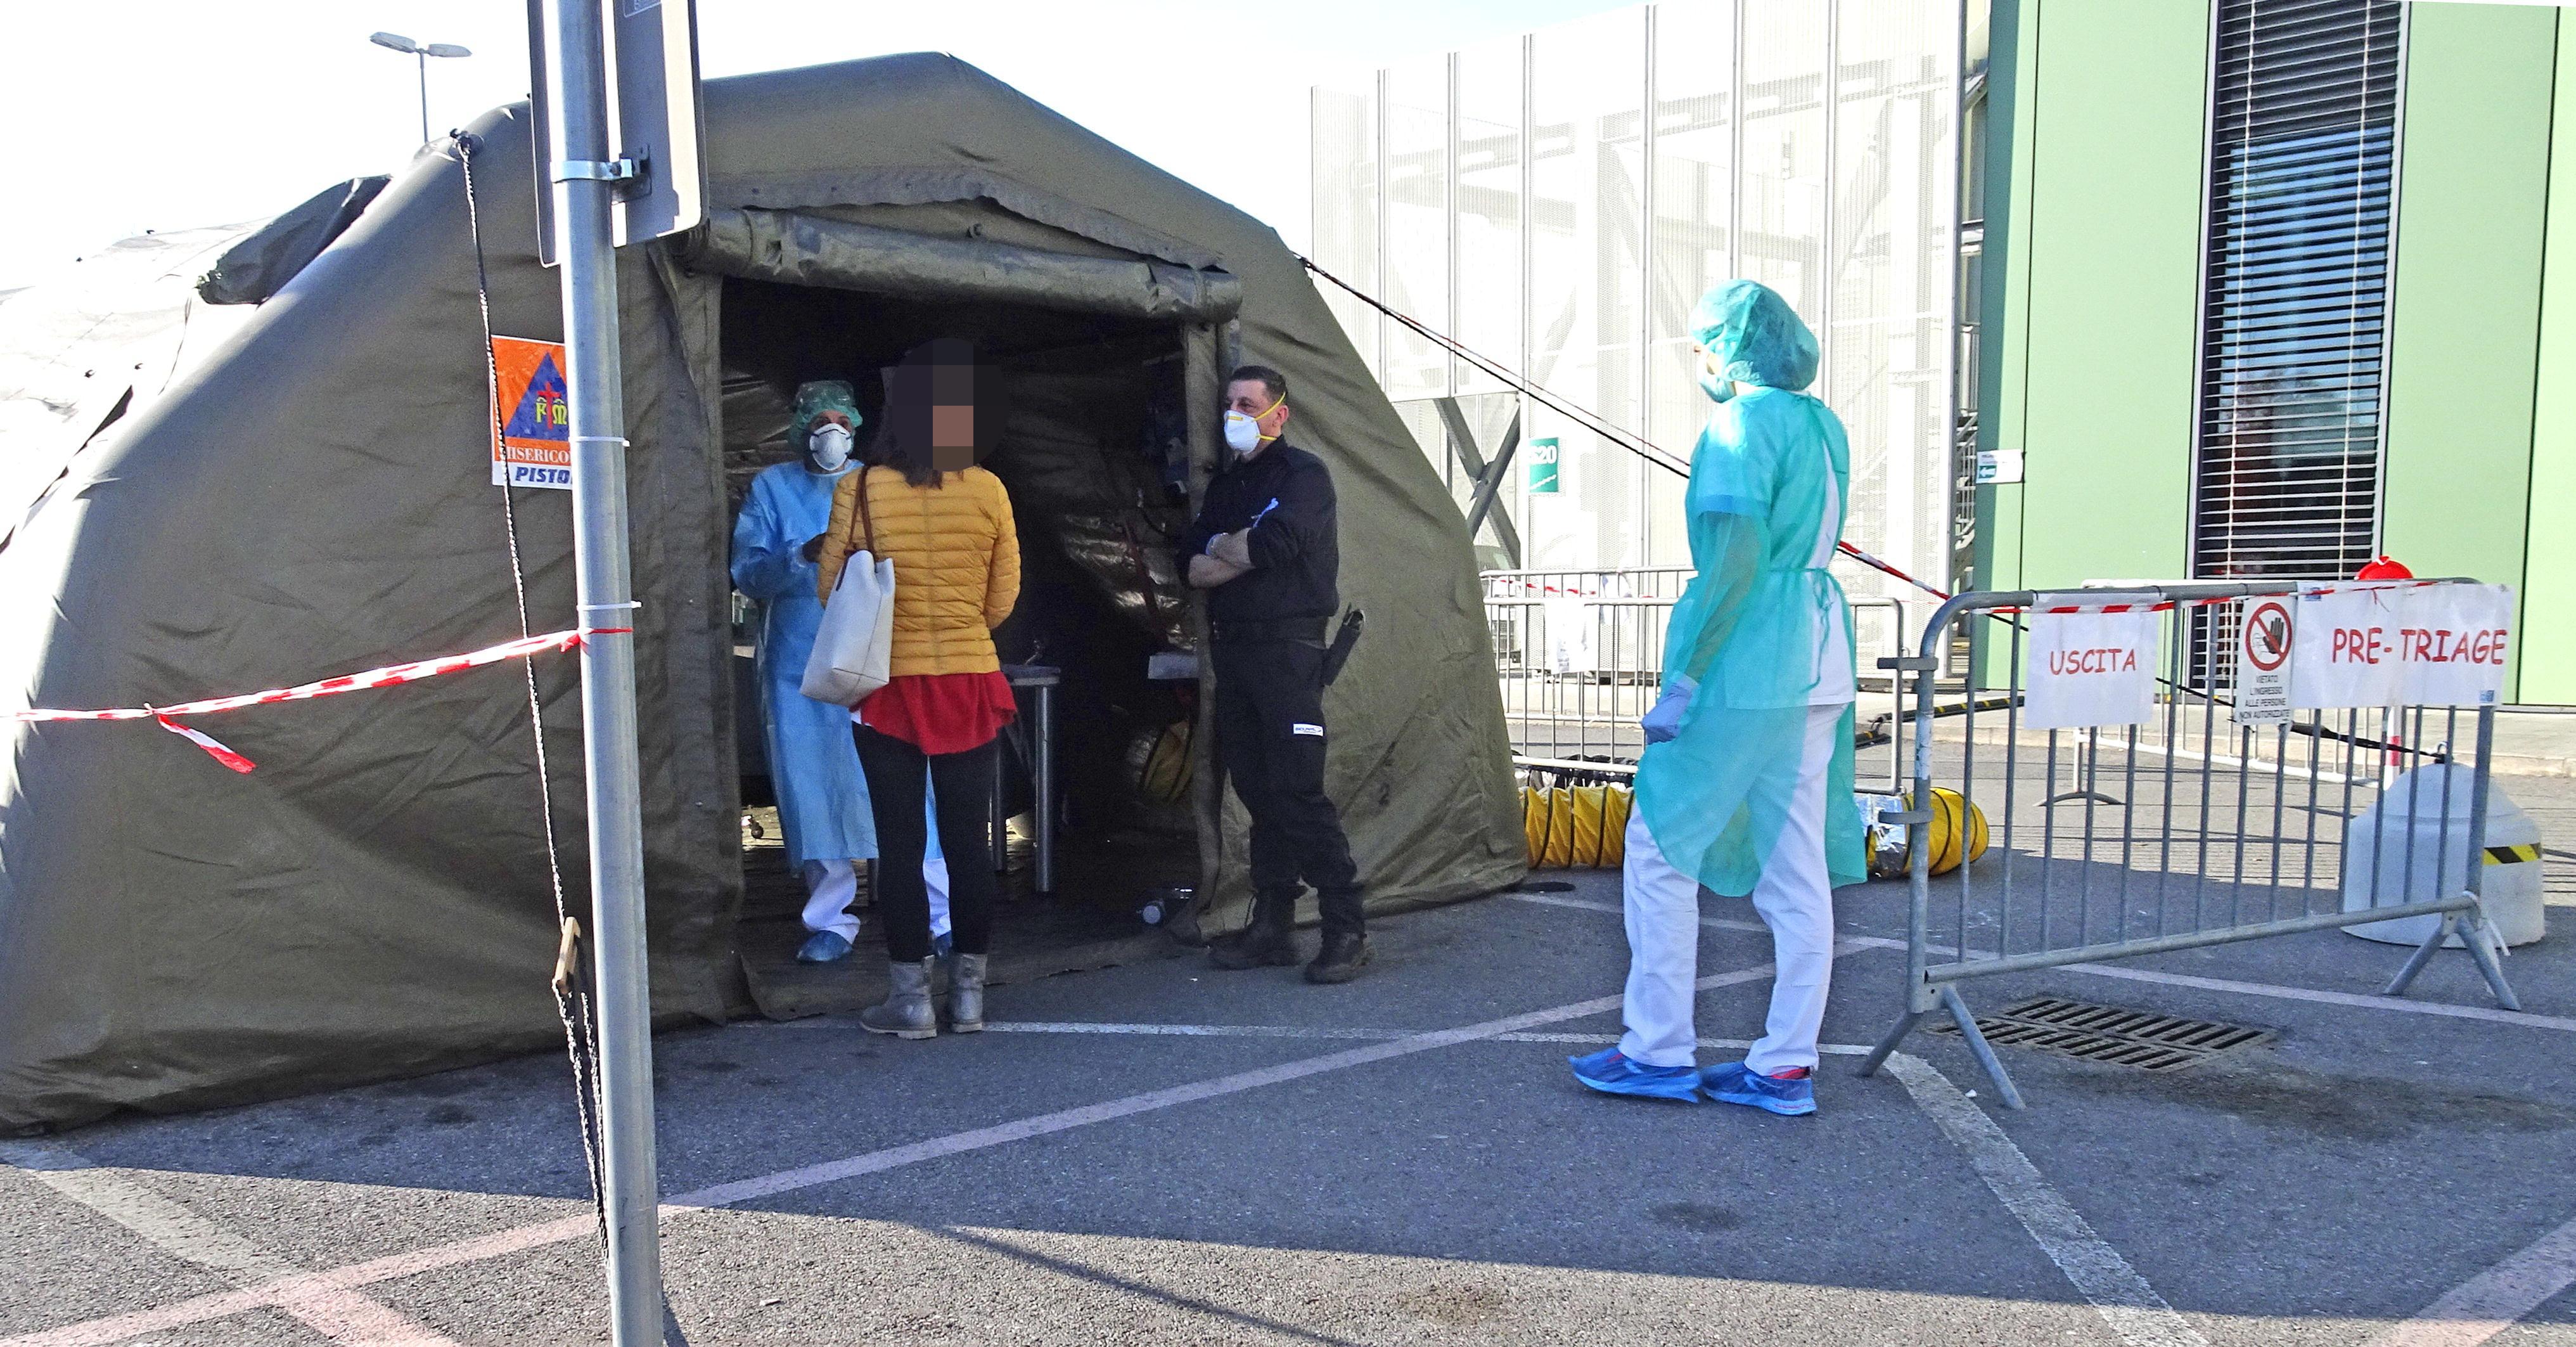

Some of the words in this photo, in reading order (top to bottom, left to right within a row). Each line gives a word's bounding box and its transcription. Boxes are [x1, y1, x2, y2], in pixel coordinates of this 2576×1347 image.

[506, 446, 570, 463] ISERICO
[515, 467, 572, 484] PISTO
[2332, 627, 2508, 664] PRE-TRIAGE
[2050, 648, 2136, 675] USCITA
